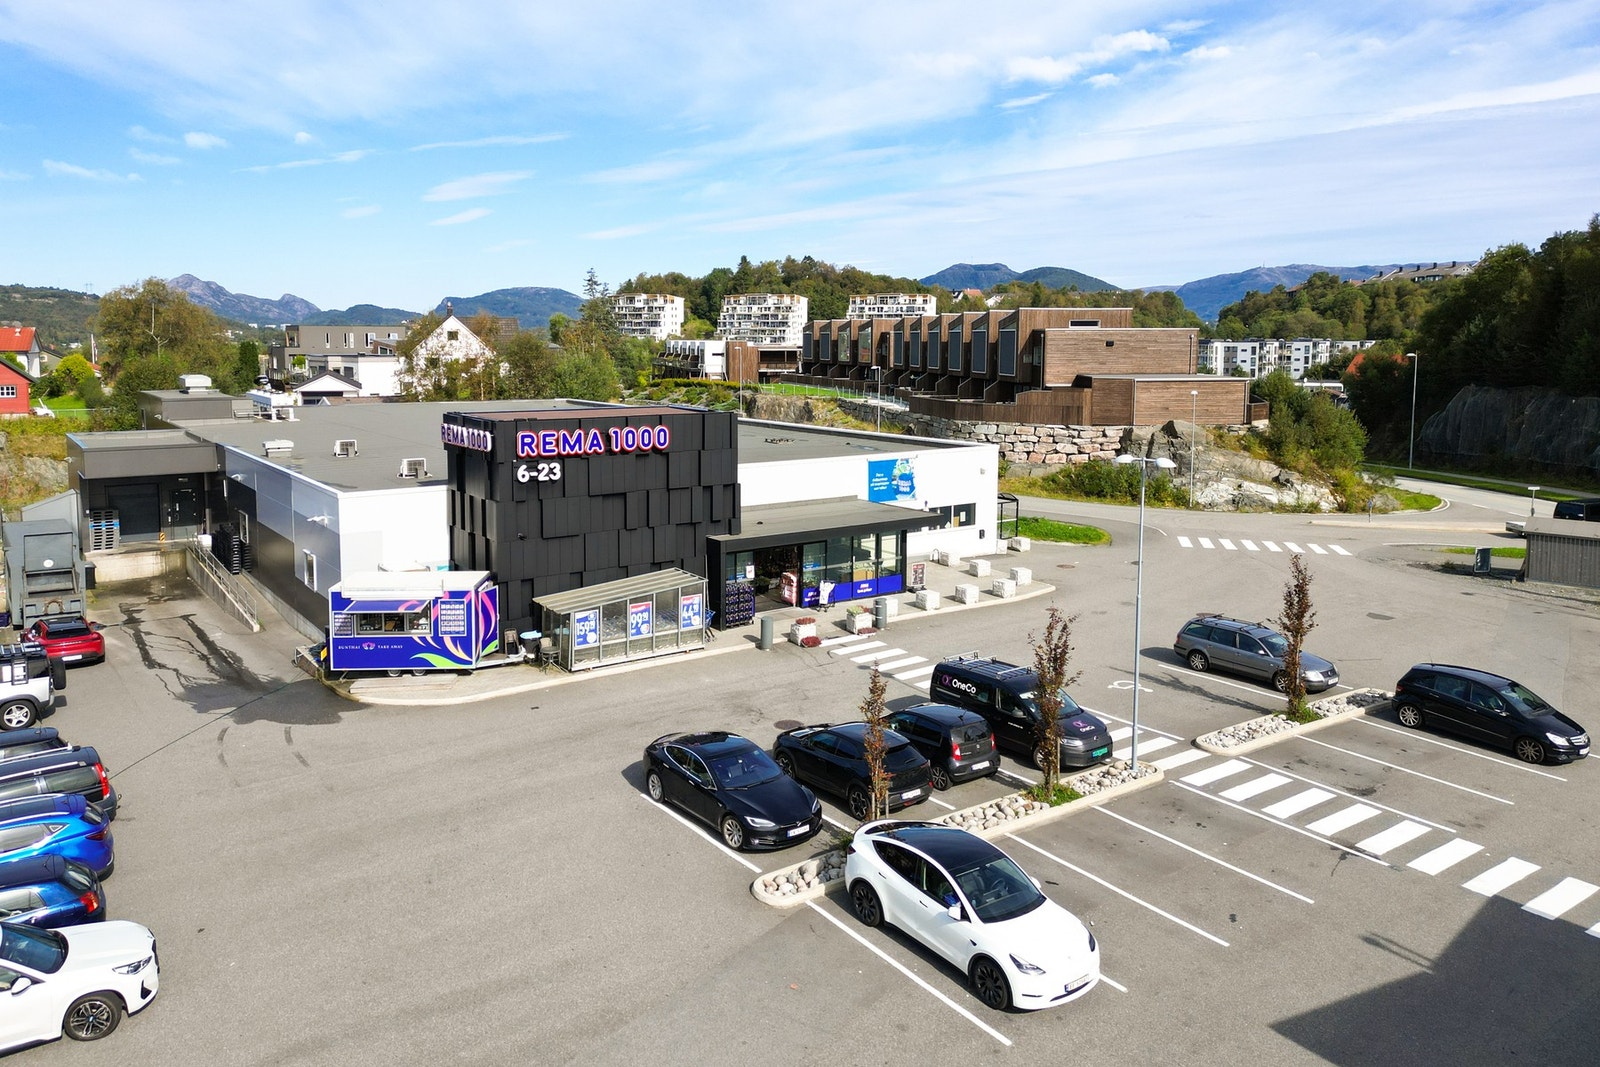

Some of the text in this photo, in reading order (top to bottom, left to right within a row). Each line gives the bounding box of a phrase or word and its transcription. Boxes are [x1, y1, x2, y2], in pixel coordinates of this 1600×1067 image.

[441, 423, 491, 452] REMA 1000
[516, 424, 669, 457] REMA 1000
[517, 462, 562, 483] 6-23
[951, 678, 977, 694] OneCo
